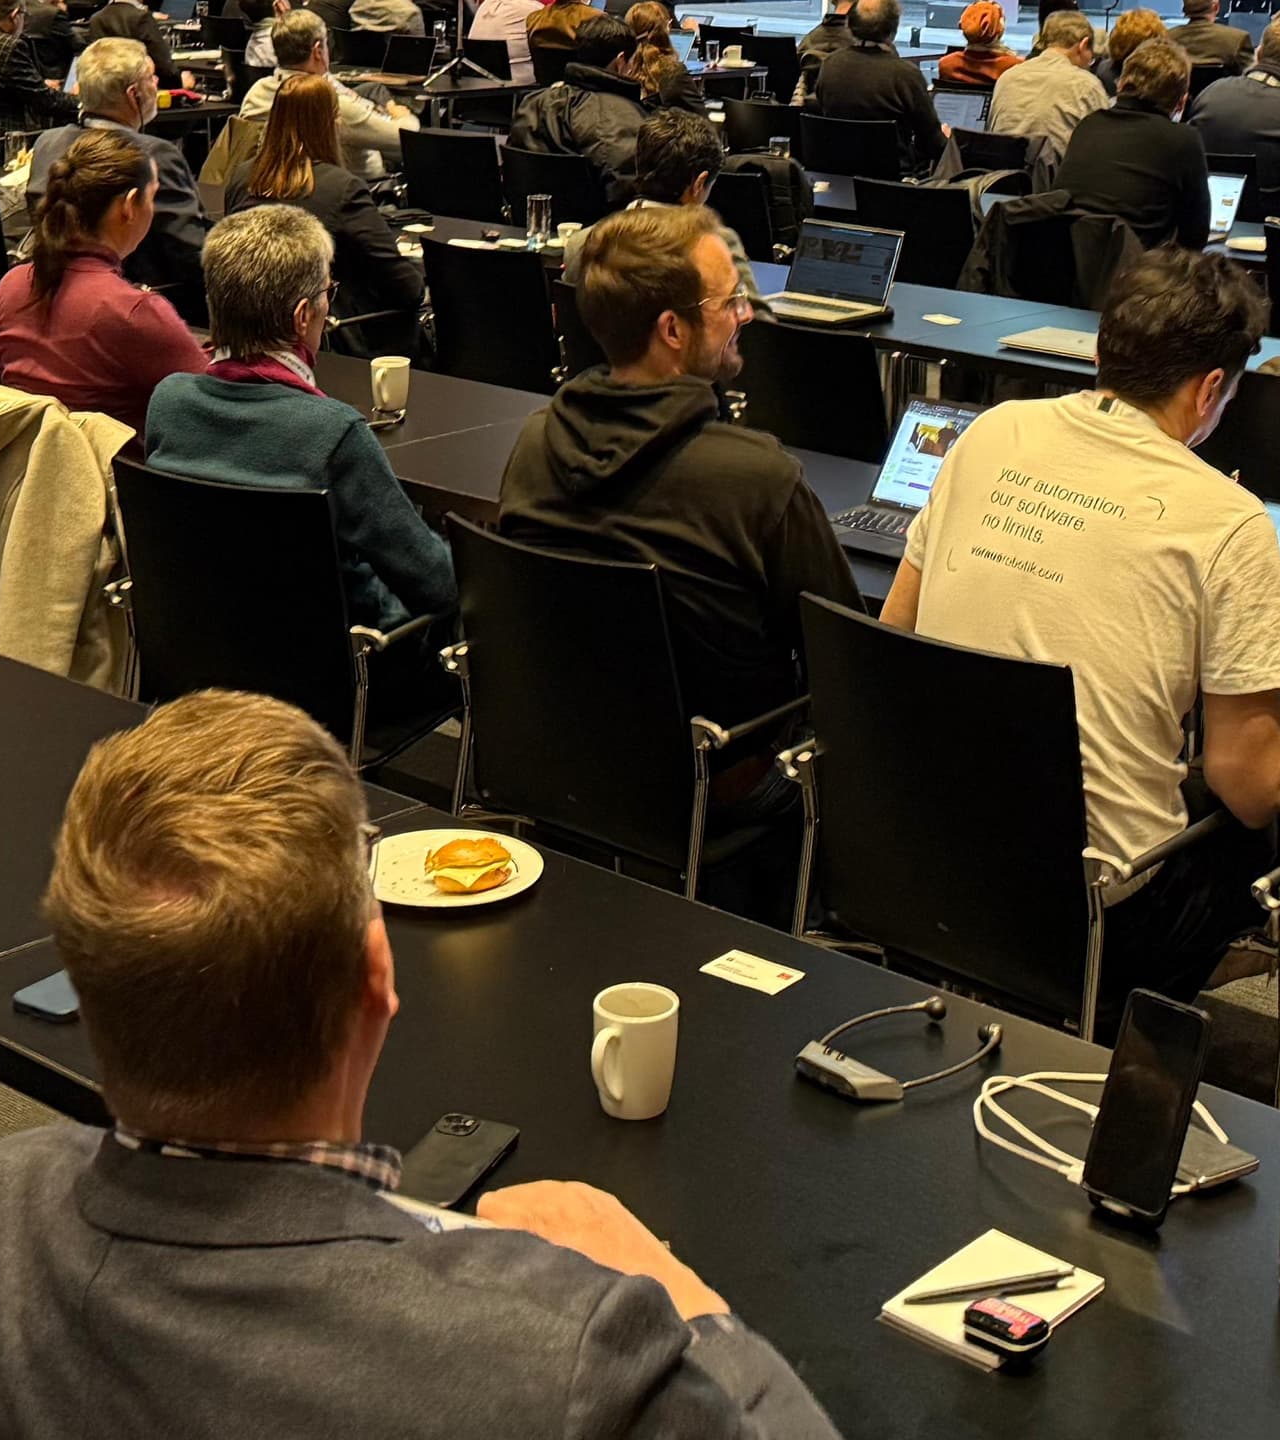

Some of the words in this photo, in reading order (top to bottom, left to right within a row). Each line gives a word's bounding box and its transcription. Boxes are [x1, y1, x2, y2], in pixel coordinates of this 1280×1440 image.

[990, 488, 1014, 507] our
[997, 467, 1032, 488] your
[1033, 478, 1127, 521] automation,
[981, 512, 1000, 529] no
